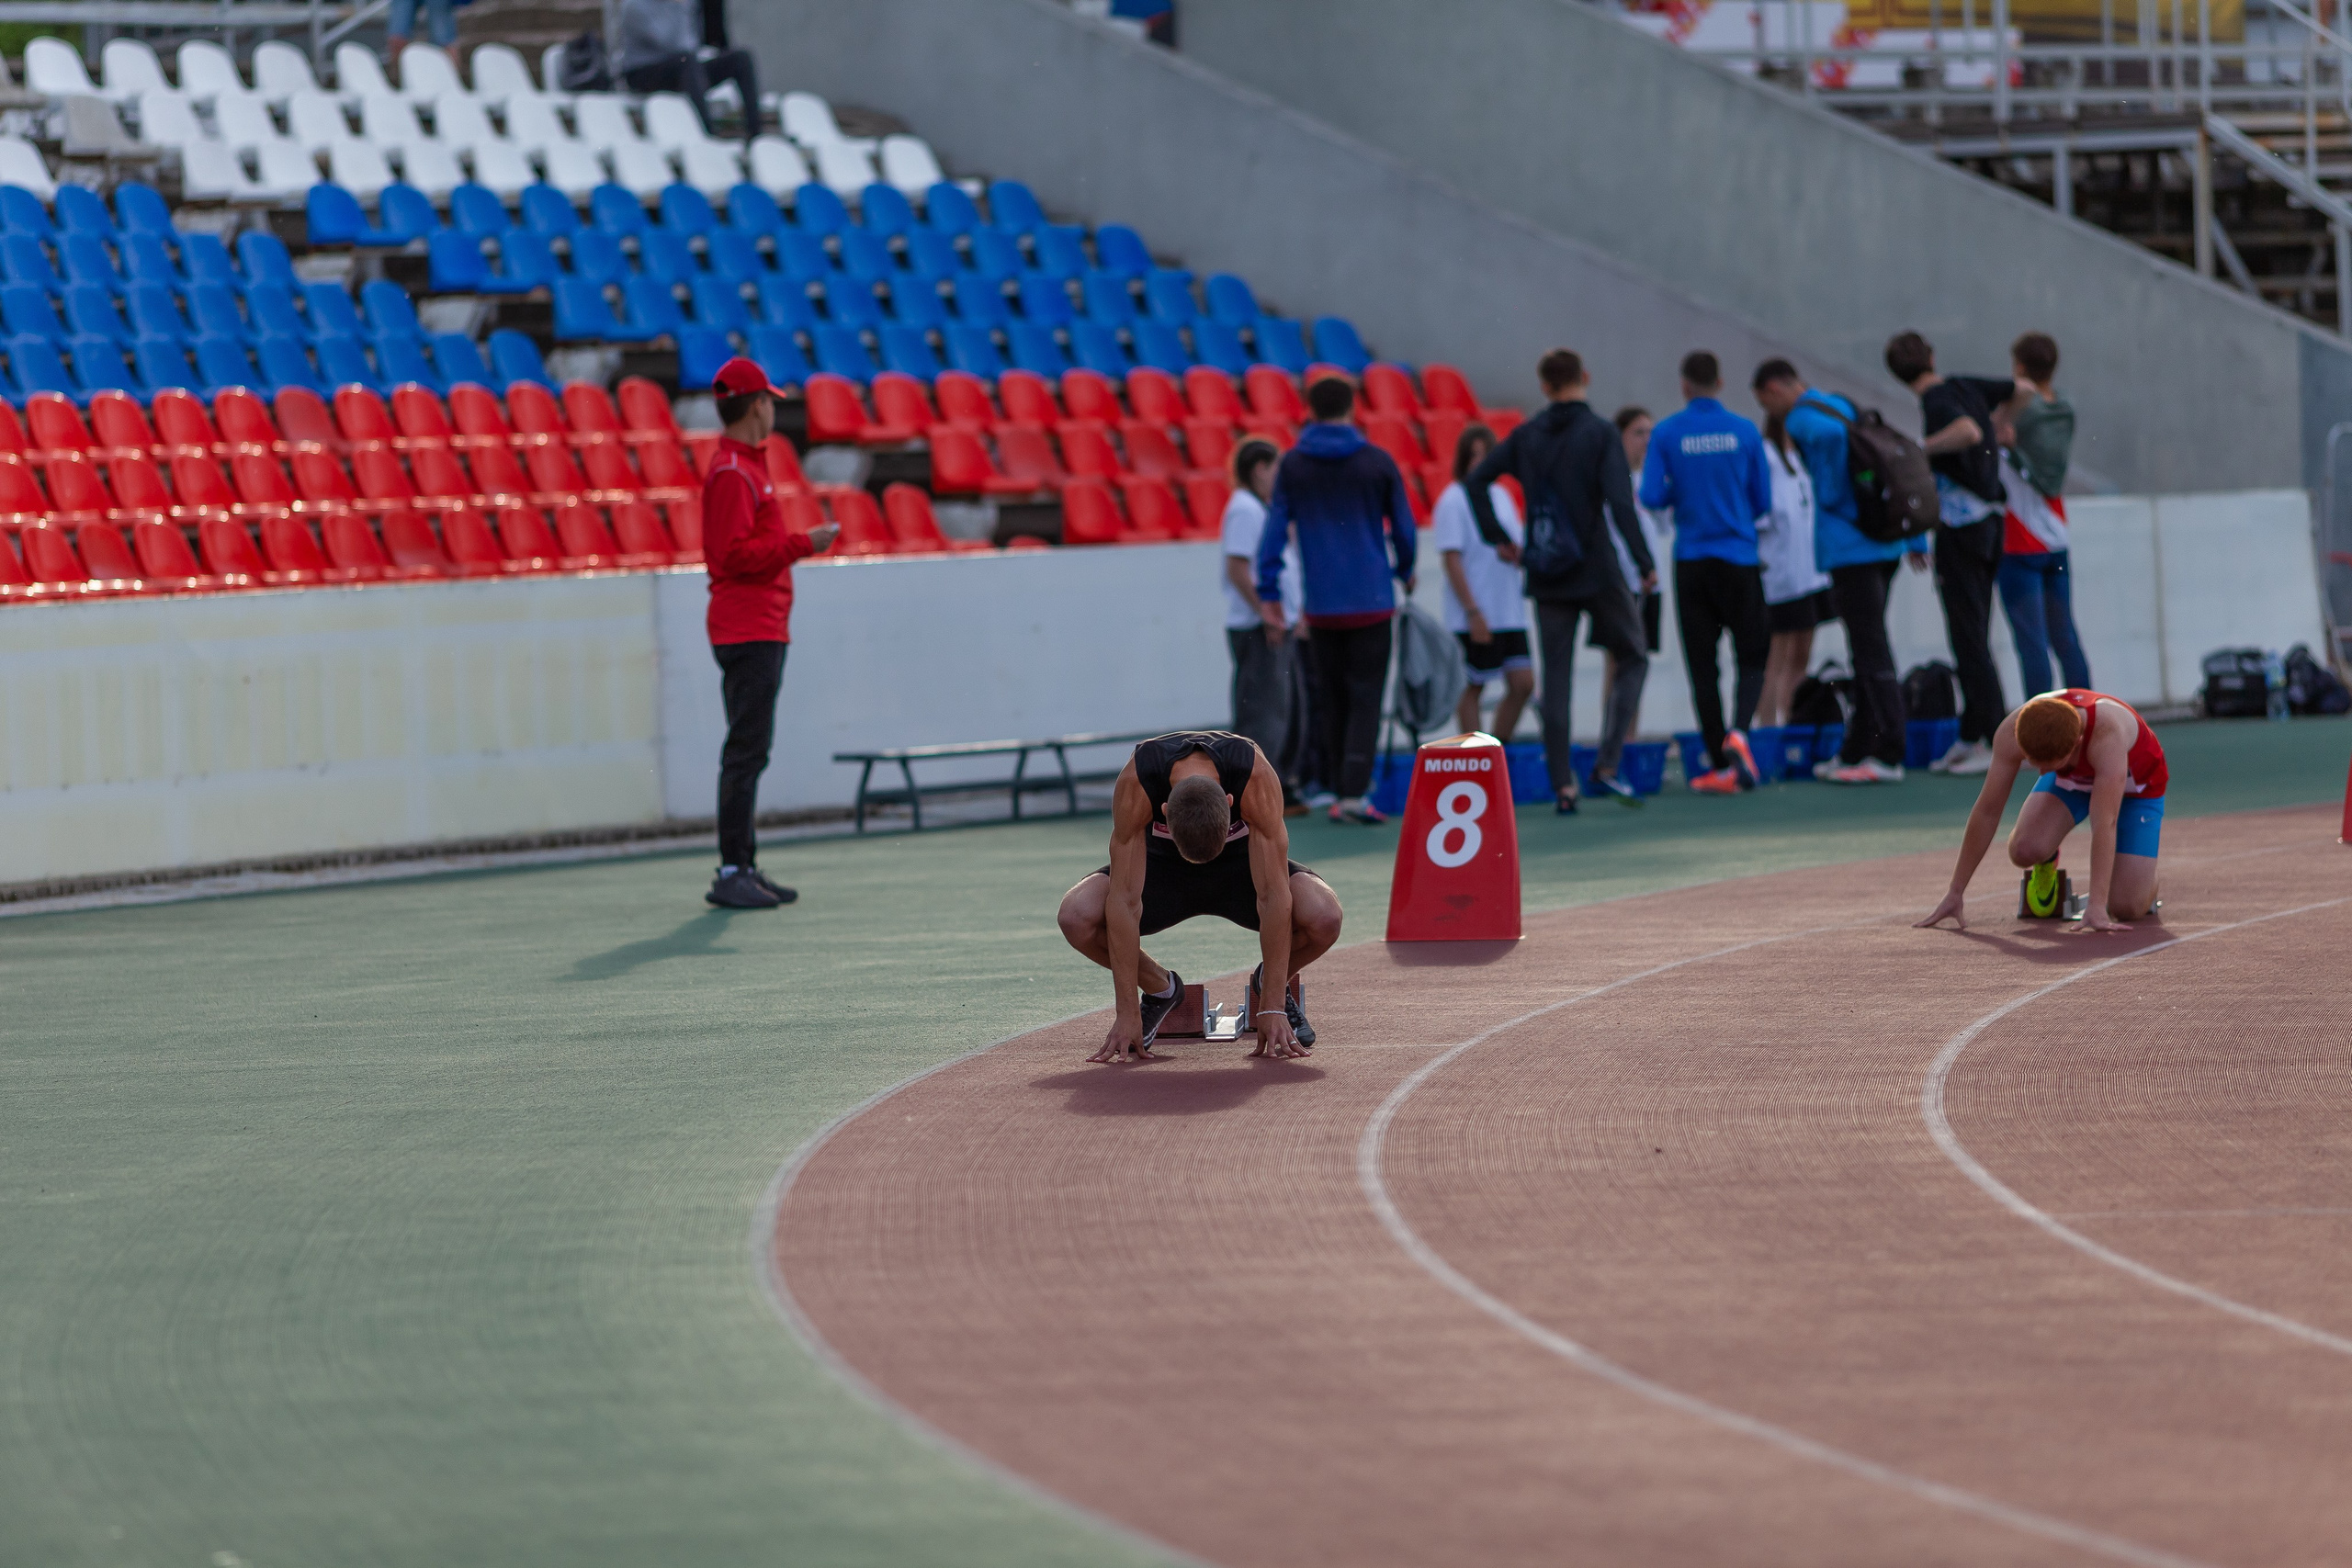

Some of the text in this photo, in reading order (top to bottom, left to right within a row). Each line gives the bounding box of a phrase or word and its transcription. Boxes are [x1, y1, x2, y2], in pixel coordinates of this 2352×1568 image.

[1681, 434, 1738, 454] RUSSIA
[1424, 758, 1492, 773] MONDO
[1426, 781, 1487, 868] 8
